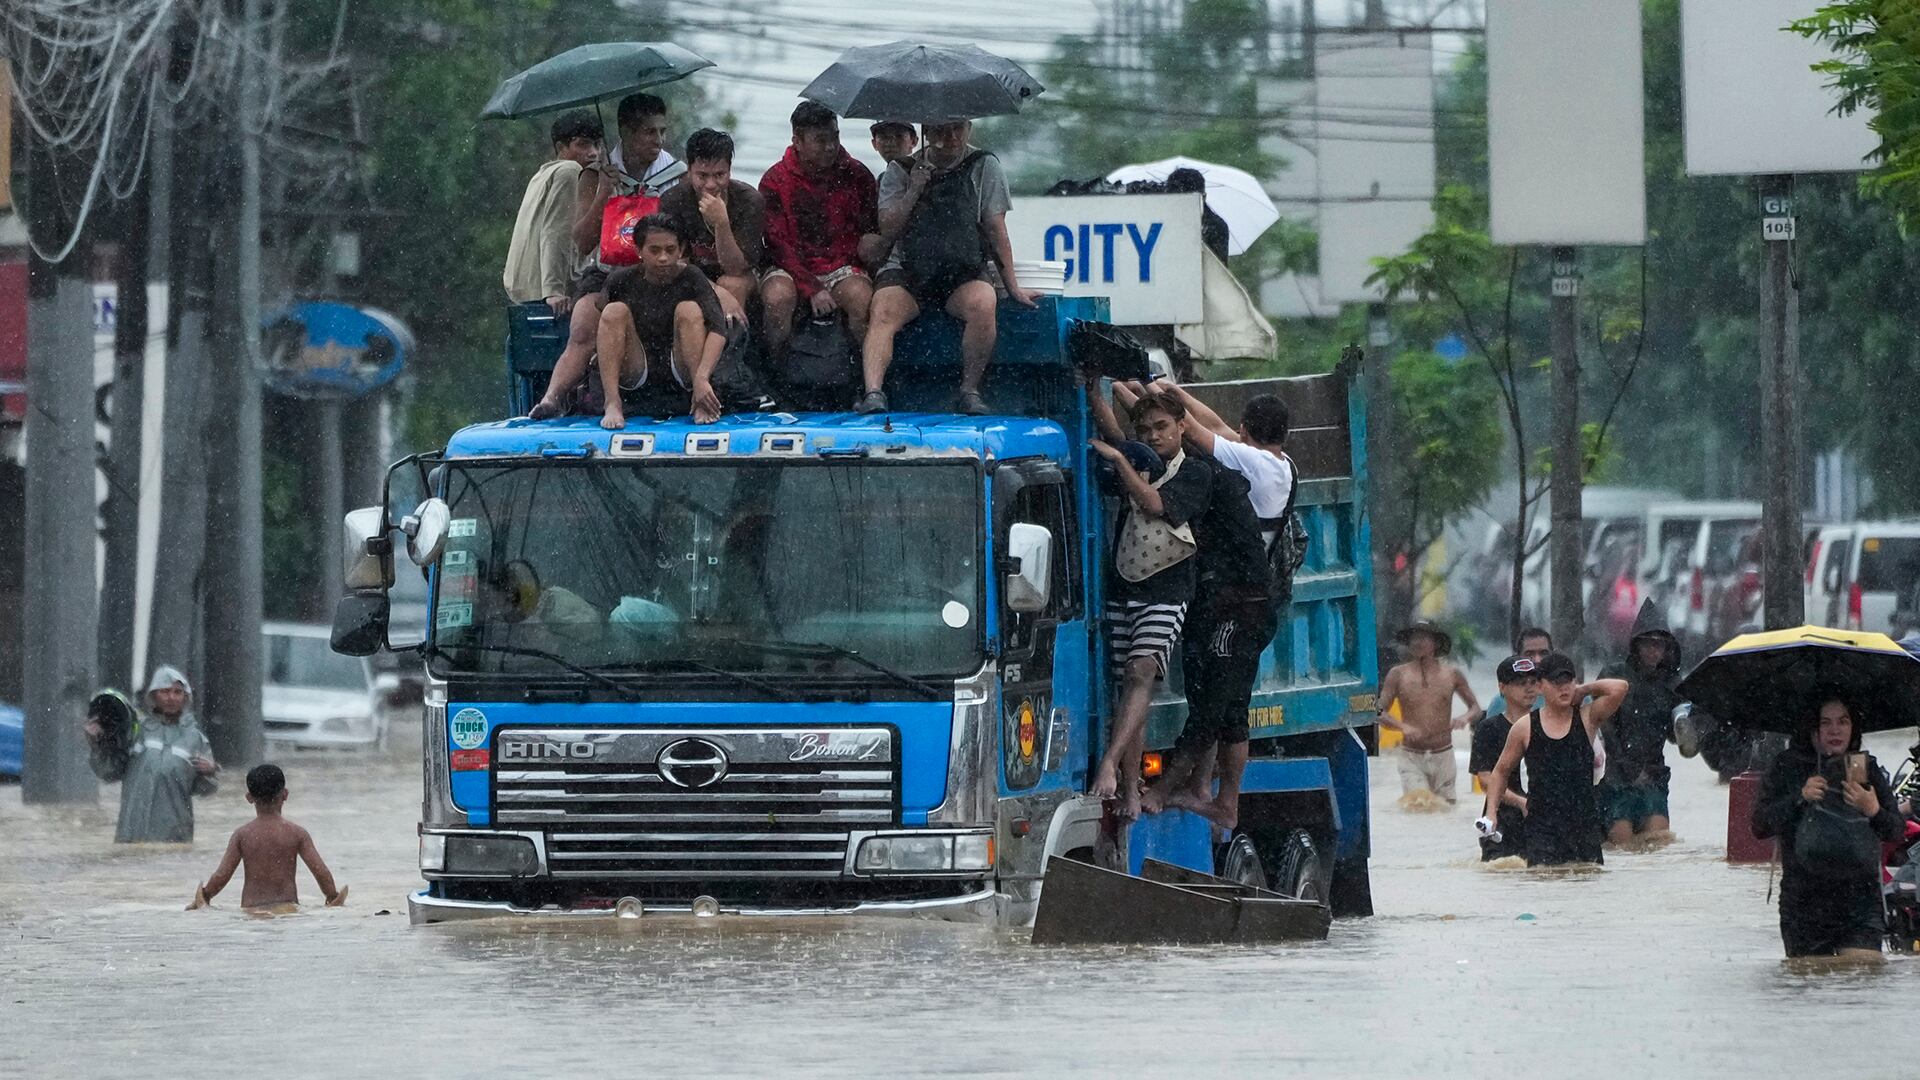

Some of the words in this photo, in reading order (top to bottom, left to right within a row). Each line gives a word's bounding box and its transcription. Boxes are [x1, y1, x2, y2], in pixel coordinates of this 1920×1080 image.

[1766, 223, 1793, 234] 105
[1044, 223, 1163, 284] CITY
[1257, 707, 1269, 727] FOR
[1269, 705, 1284, 726] HIRE
[454, 721, 484, 733] TRUCK
[505, 742, 595, 758] HINO
[789, 734, 858, 761] Boston
